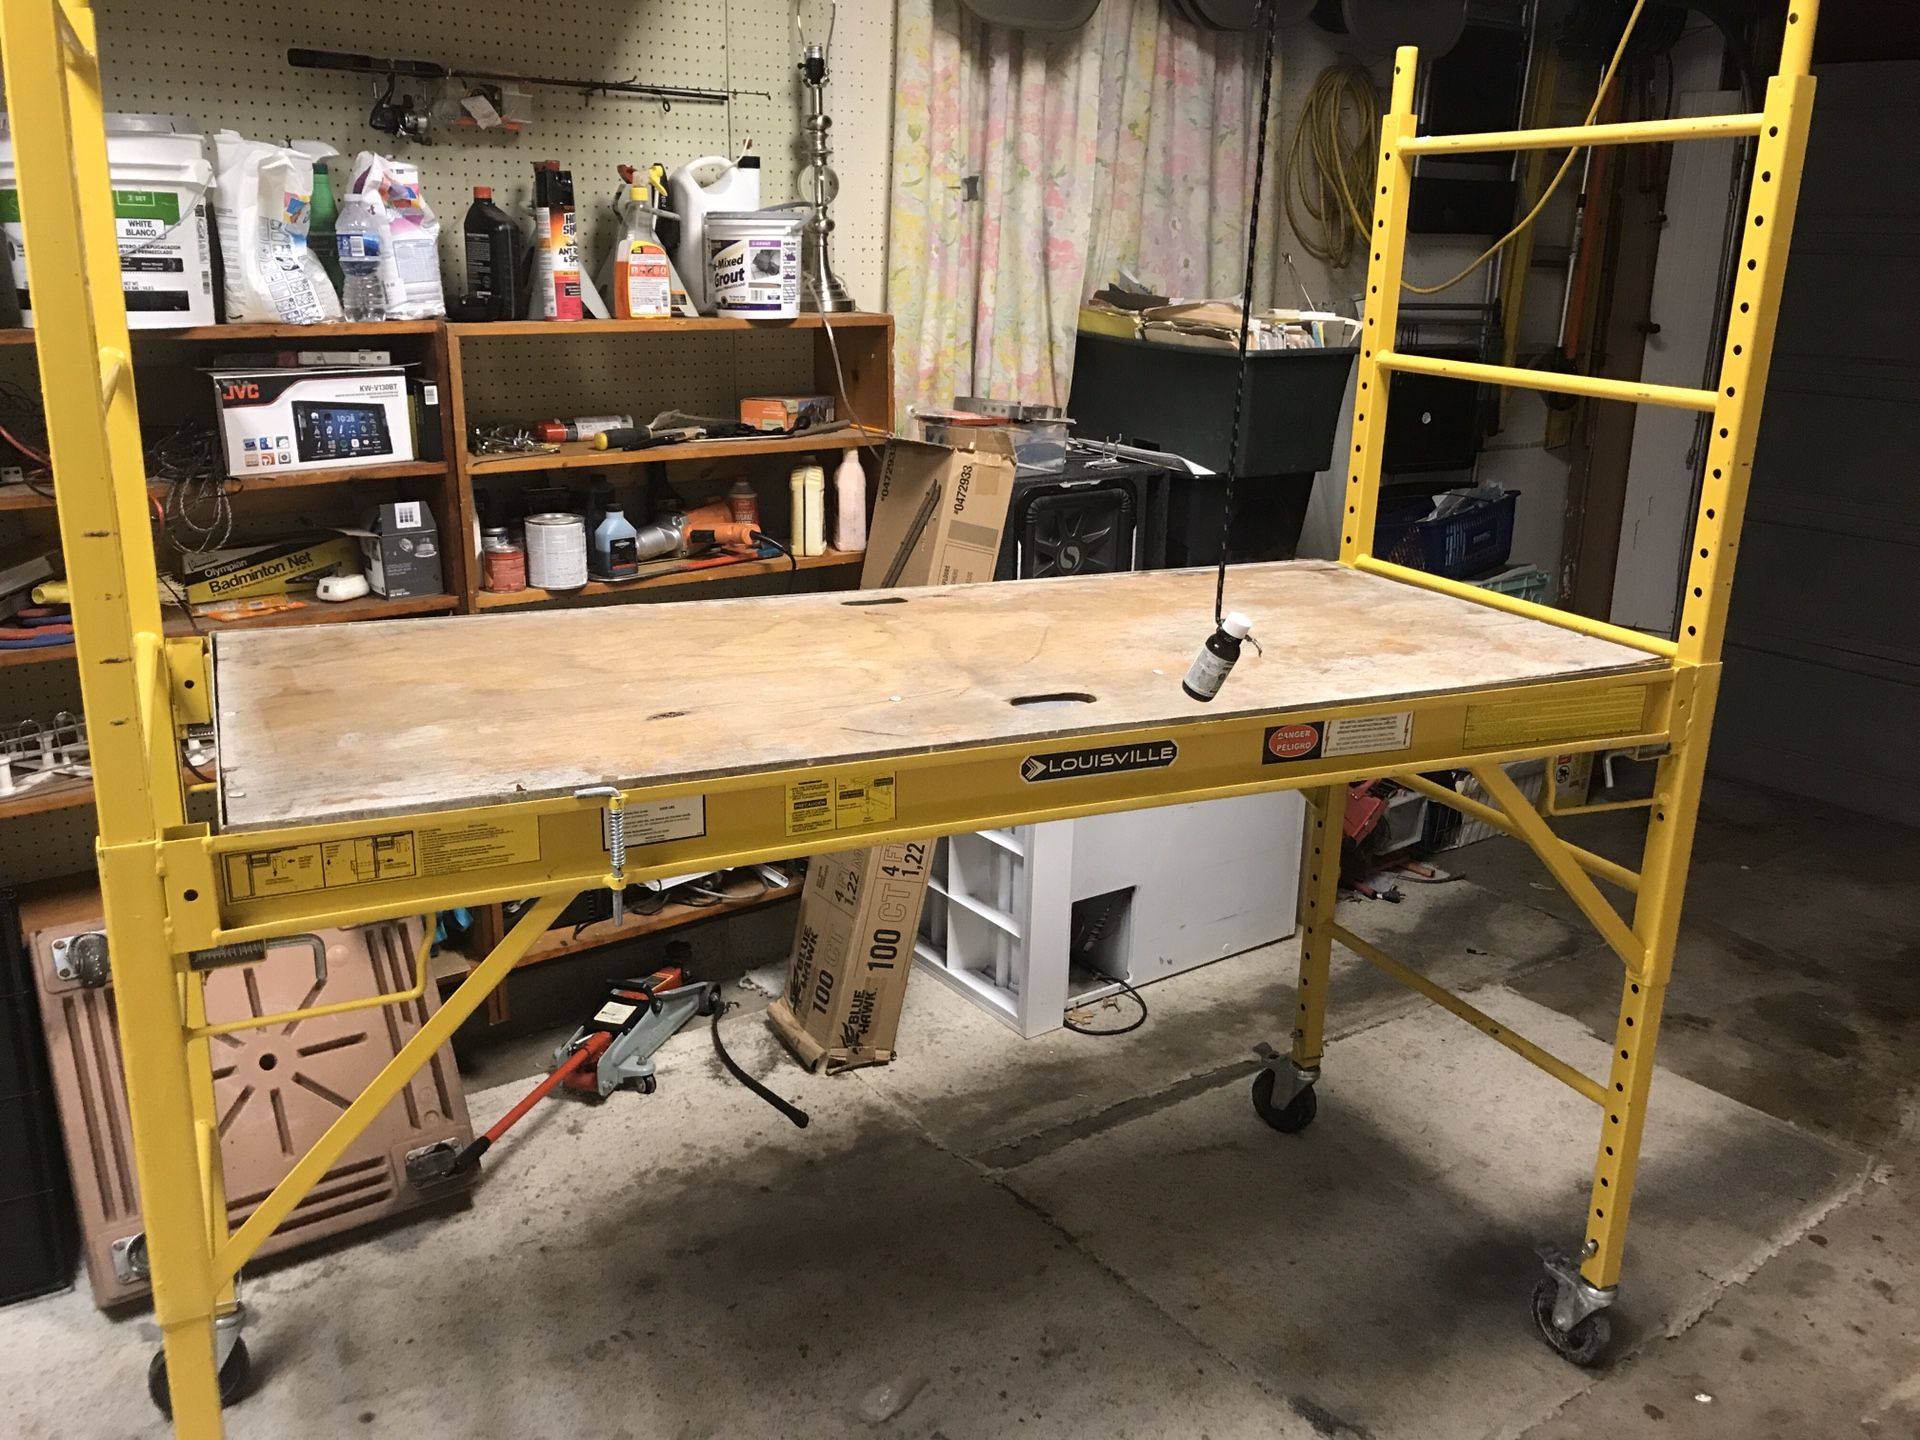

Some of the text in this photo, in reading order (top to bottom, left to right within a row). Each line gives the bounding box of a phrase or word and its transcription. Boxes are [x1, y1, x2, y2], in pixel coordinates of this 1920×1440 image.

[125, 228, 157, 237] BLANCO
[128, 219, 152, 228] WHITE
[558, 248, 573, 256] ANT
[714, 267, 745, 288] Grout
[222, 383, 260, 400] JVC
[359, 382, 398, 392] KW-V130BT
[204, 559, 248, 578] Olympian
[208, 562, 286, 593] Badminton
[286, 552, 313, 570] Net
[1277, 729, 1311, 740] DANGER
[1276, 741, 1311, 752] PELIGRO
[1049, 746, 1174, 773] LOUISVILLE
[901, 842, 926, 877] 1,22
[881, 865, 900, 877] 4
[834, 888, 844, 902] 4
[867, 882, 911, 971] 100 CT
[796, 924, 812, 972] BLUE
[812, 969, 834, 1015] 100
[848, 989, 866, 1025] BLUE
[858, 989, 878, 1034] HAWK
